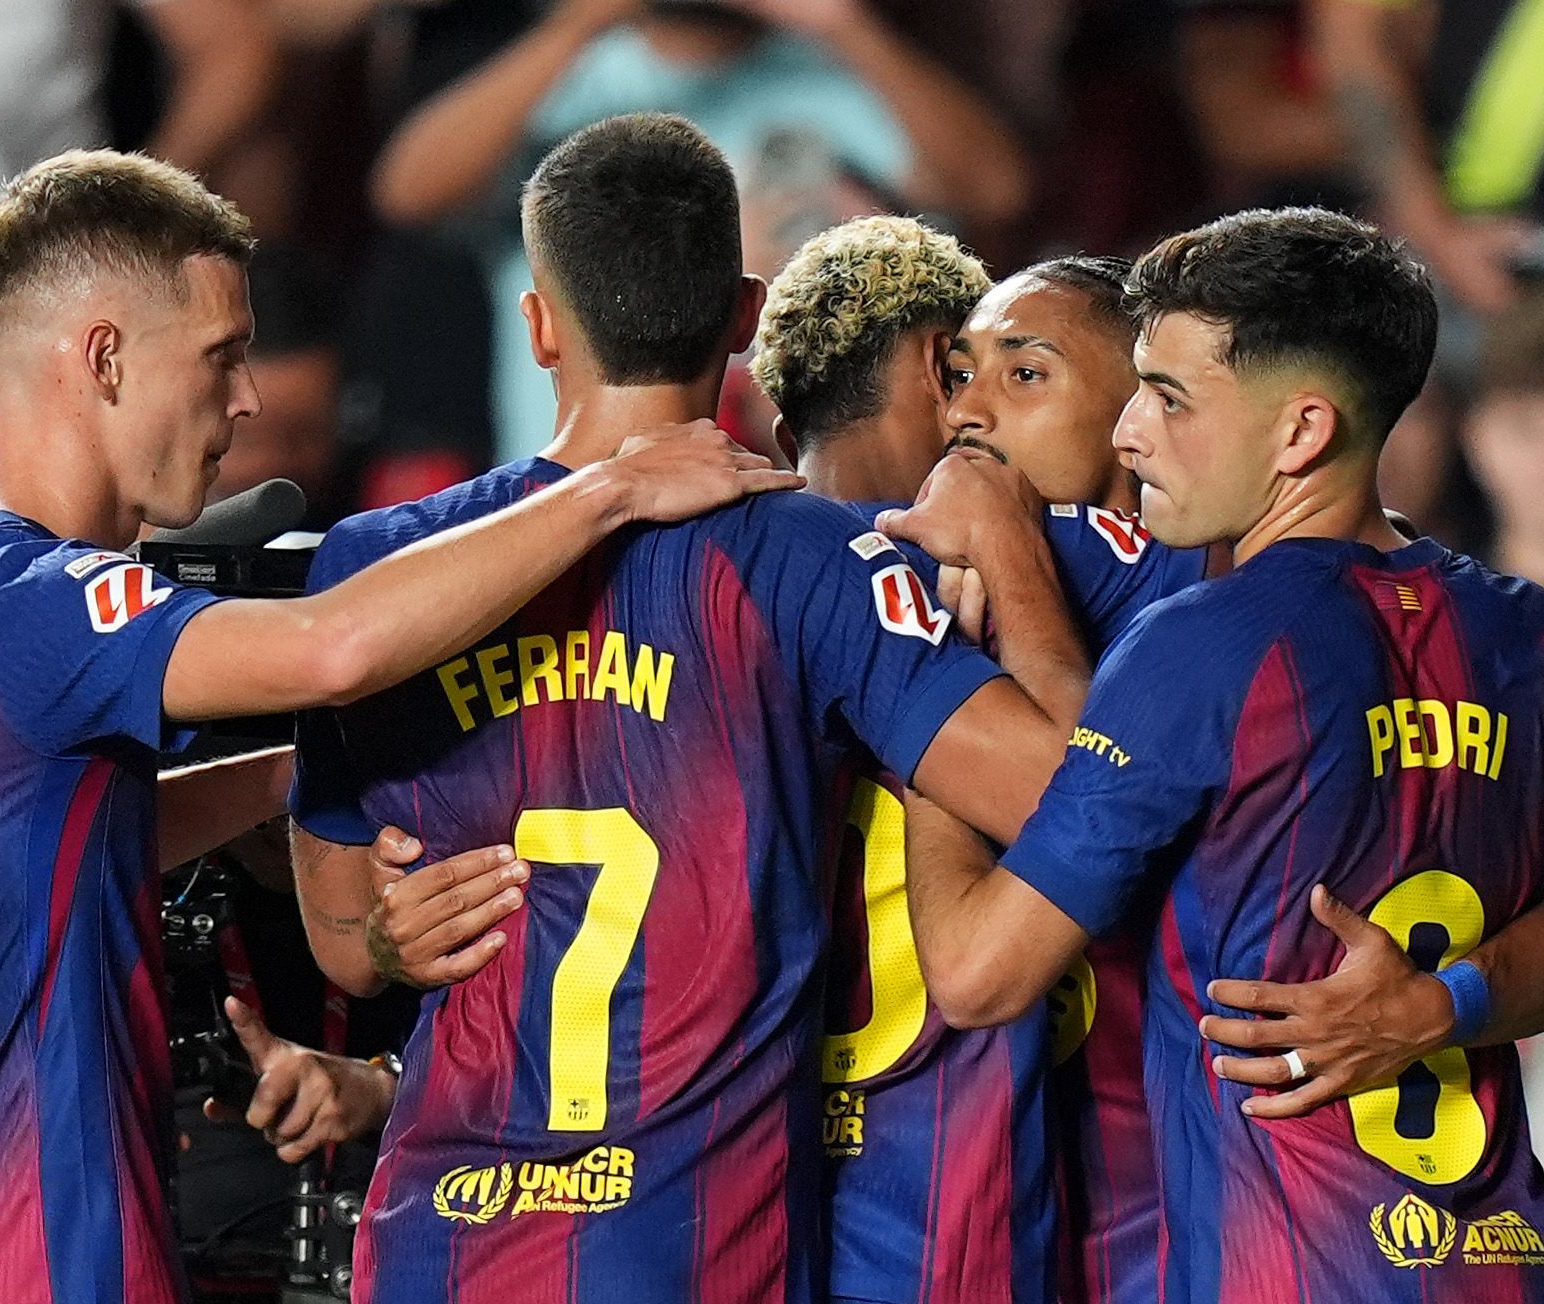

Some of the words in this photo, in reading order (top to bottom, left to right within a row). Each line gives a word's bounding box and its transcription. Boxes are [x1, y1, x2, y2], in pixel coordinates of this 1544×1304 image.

[435, 630, 676, 733] FERRAN
[1109, 746, 1131, 767] tv
[1366, 698, 1508, 780] PEDRI
[513, 807, 661, 1132] 7
[1345, 870, 1487, 1185] 8
[1463, 1254, 1481, 1264] The
[1482, 1253, 1496, 1264] UN
